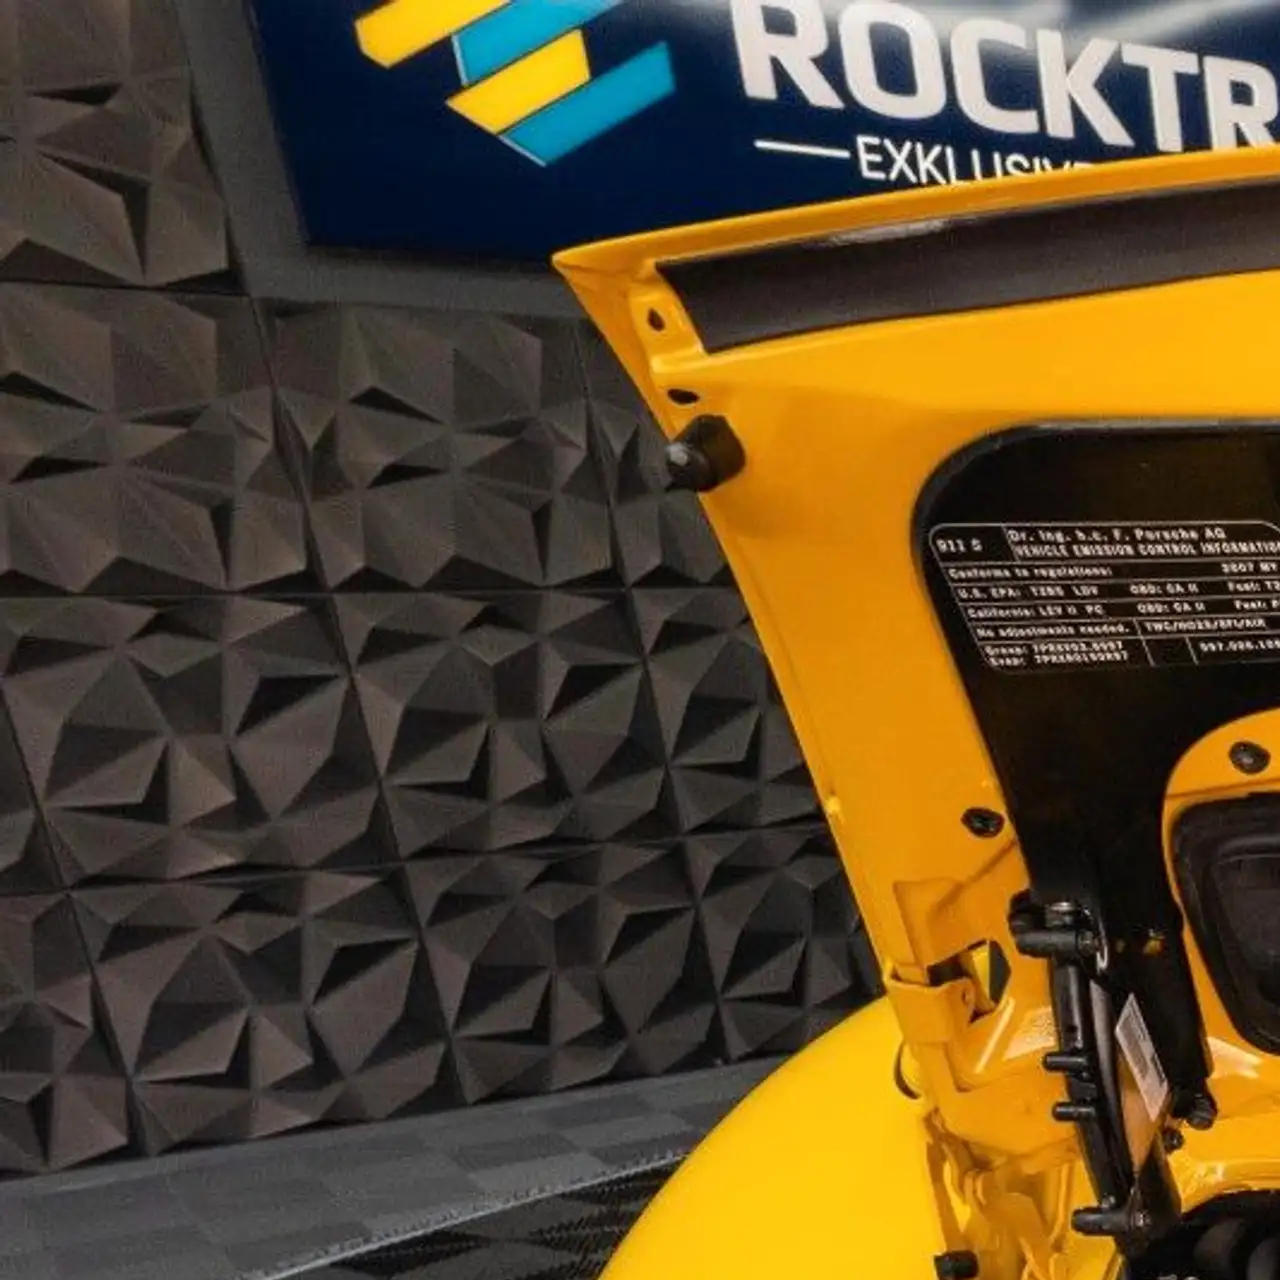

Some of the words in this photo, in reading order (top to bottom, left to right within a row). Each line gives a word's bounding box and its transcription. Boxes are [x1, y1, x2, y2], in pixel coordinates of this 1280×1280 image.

[1007, 529, 1034, 542] Dr.
[1038, 529, 1071, 543] Ing.
[1134, 528, 1198, 541] Porsche
[1204, 527, 1227, 539] AG
[936, 538, 966, 552] 911
[1014, 544, 1069, 557] VEHICLE
[1072, 543, 1134, 556] EMISSION
[1138, 542, 1197, 555] CONTROL
